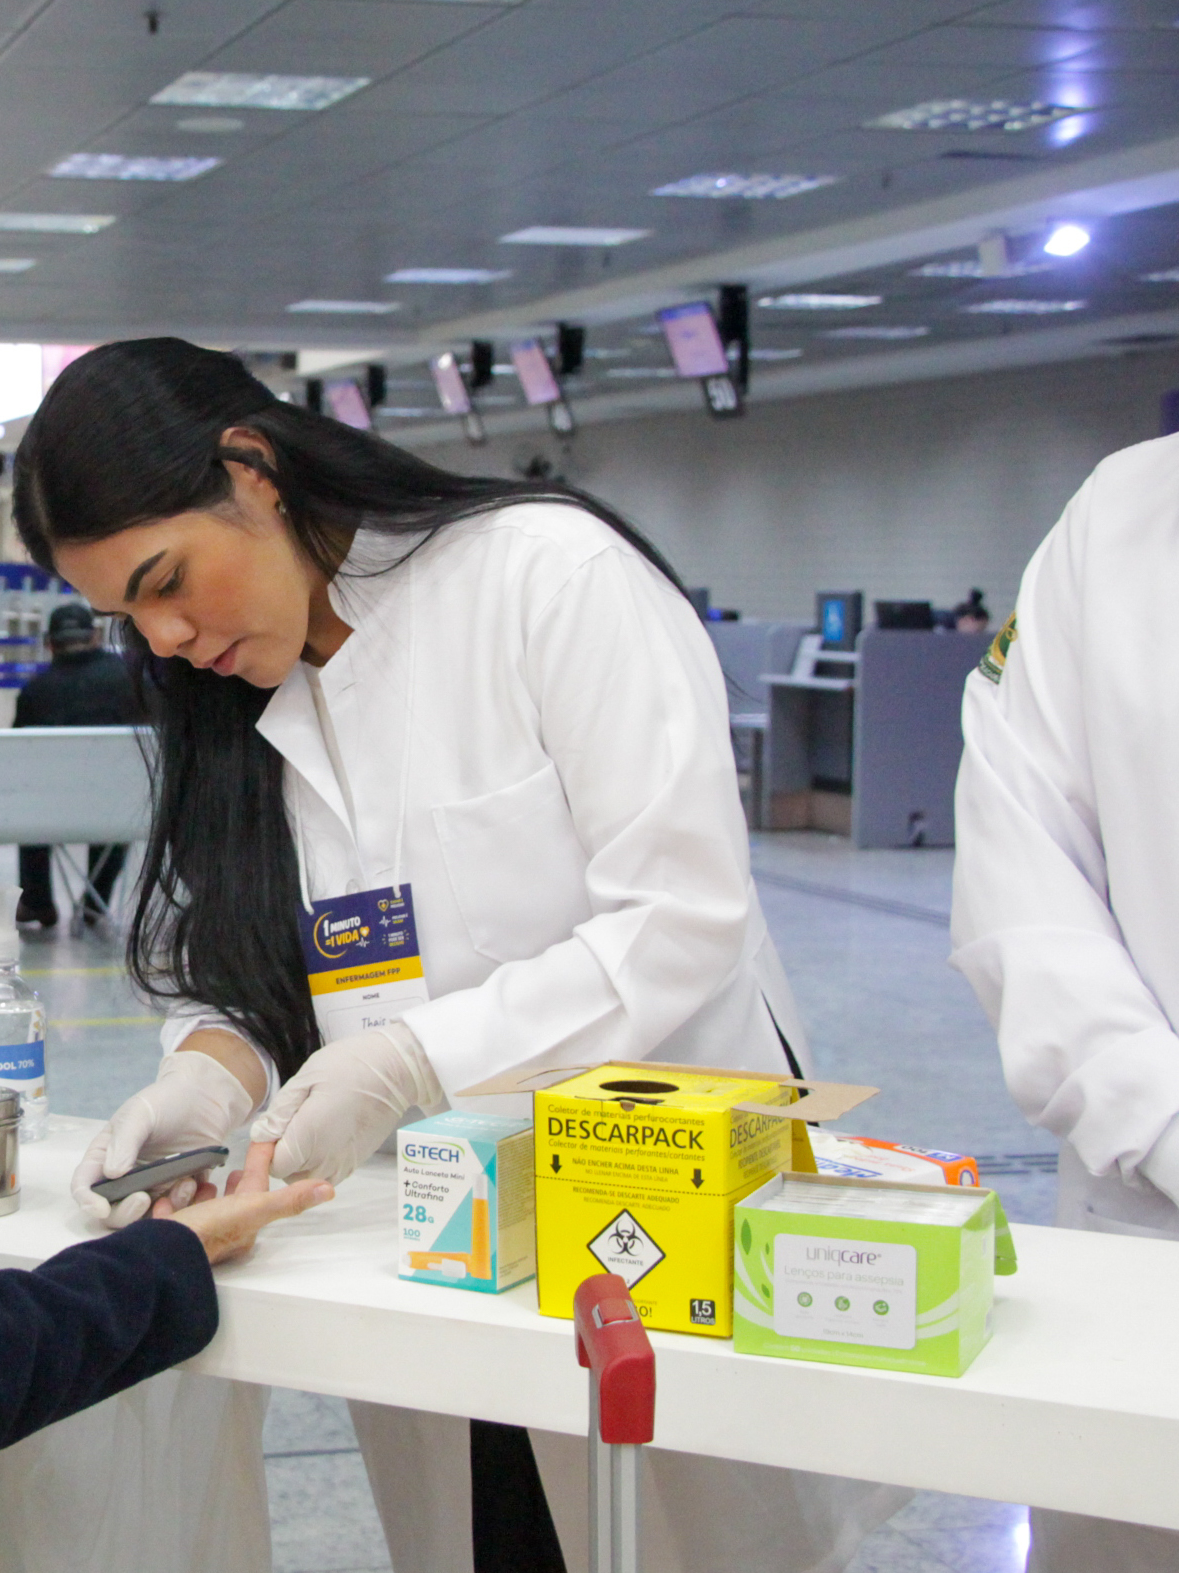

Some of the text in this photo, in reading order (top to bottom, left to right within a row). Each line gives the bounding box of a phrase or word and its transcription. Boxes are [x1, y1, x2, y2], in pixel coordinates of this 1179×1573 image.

[330, 916, 361, 933] MINUTO
[336, 929, 360, 945] VIDA
[336, 970, 385, 984] ENFERMAGEM
[18, 1058, 35, 1069] 70%
[548, 1104, 579, 1115] Coletor
[581, 1106, 591, 1116] de
[633, 1112, 705, 1127] perfurocortantes
[548, 1116, 705, 1151] DESCARPACK
[548, 1138, 578, 1150] Colector
[579, 1141, 589, 1151] de
[590, 1143, 624, 1155] materiais
[588, 1159, 613, 1169] ENCHER
[614, 1162, 635, 1171] ACIMA
[659, 1167, 679, 1175] LINHA
[412, 1180, 450, 1193] Conforto
[405, 1189, 444, 1202] Ultrafina
[617, 1191, 645, 1200] DESCARTE
[403, 1228, 421, 1237] 100
[607, 1256, 644, 1266] INFECTANTE
[784, 1265, 904, 1287] Lenços para assepsia
[692, 1299, 712, 1316] 1,5
